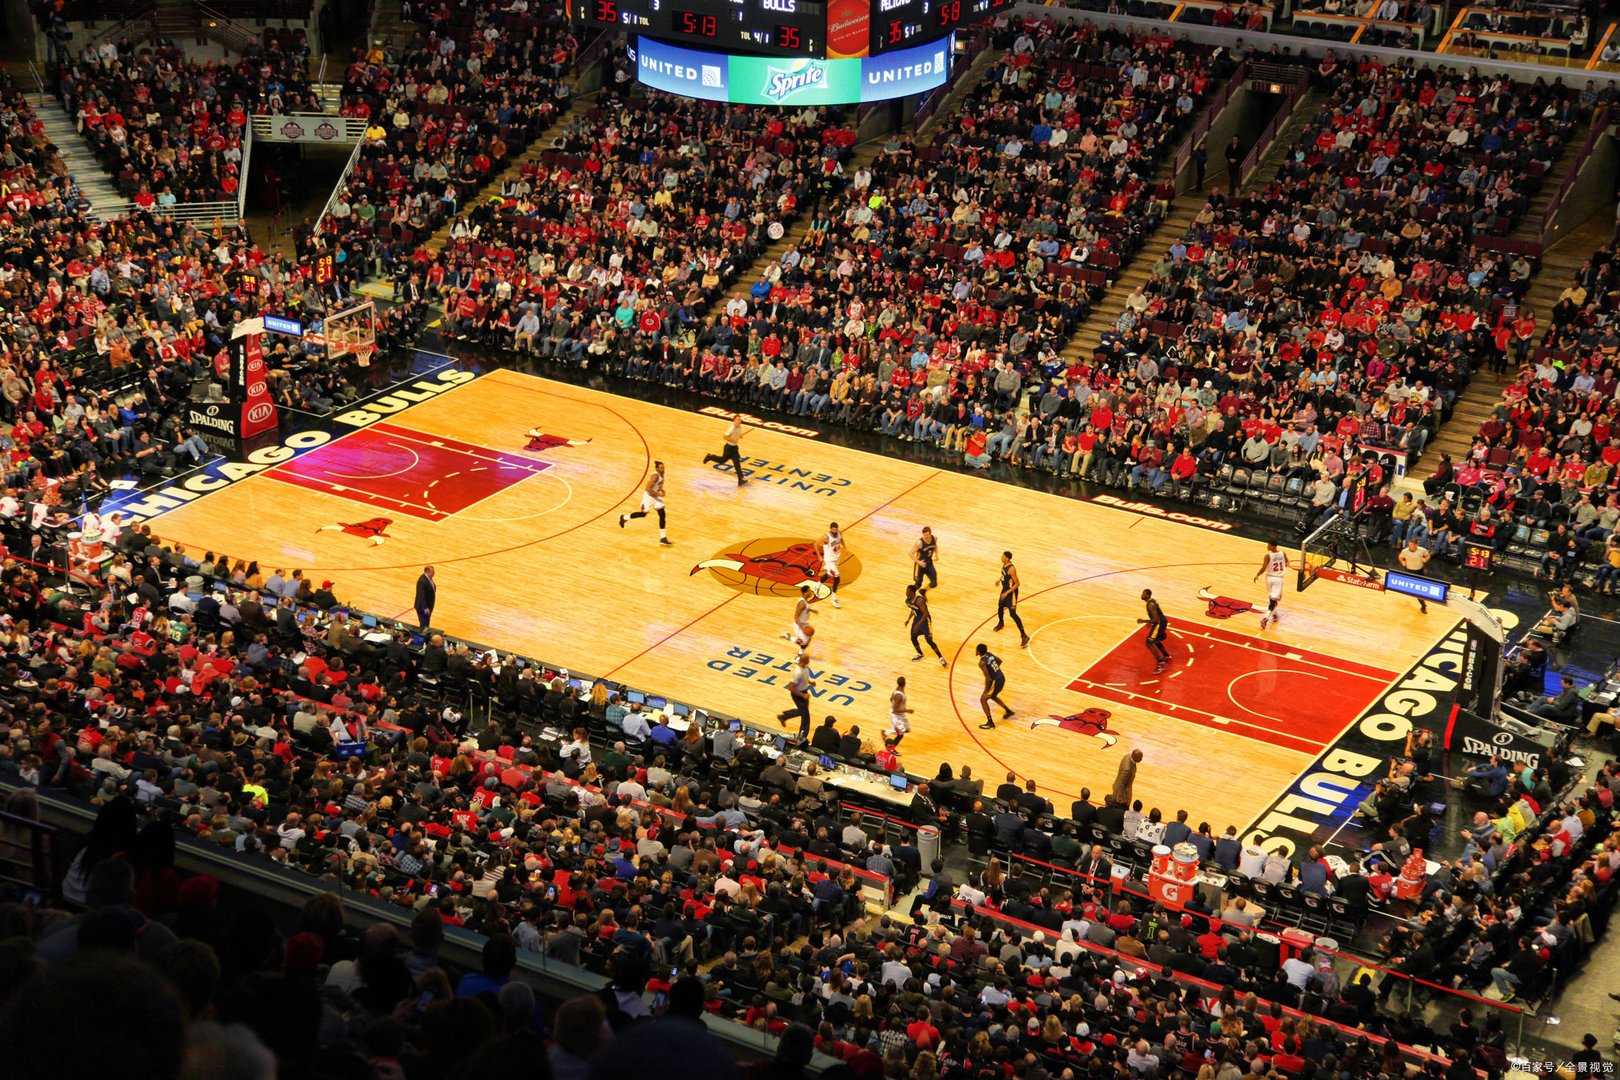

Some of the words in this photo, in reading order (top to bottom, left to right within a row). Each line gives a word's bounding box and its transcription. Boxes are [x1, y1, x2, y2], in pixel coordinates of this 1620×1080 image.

[598, 1, 617, 22] 35
[763, 0, 795, 12] BULLS
[683, 13, 717, 36] 5:13
[780, 26, 800, 49] 35
[641, 54, 698, 80] UNITED
[868, 61, 931, 84] UNITED
[768, 63, 823, 99] Sprite
[267, 320, 292, 330] UNITED
[333, 369, 475, 427] BULLS
[189, 410, 235, 435] SPALDING
[251, 406, 269, 420] KIA
[1092, 494, 1233, 530] Bulls.com
[1469, 556, 1484, 568] 21
[1471, 547, 1490, 559] 5:13
[1273, 562, 1283, 572] 21
[1391, 578, 1429, 592] UNITED
[1162, 883, 1178, 901] G
